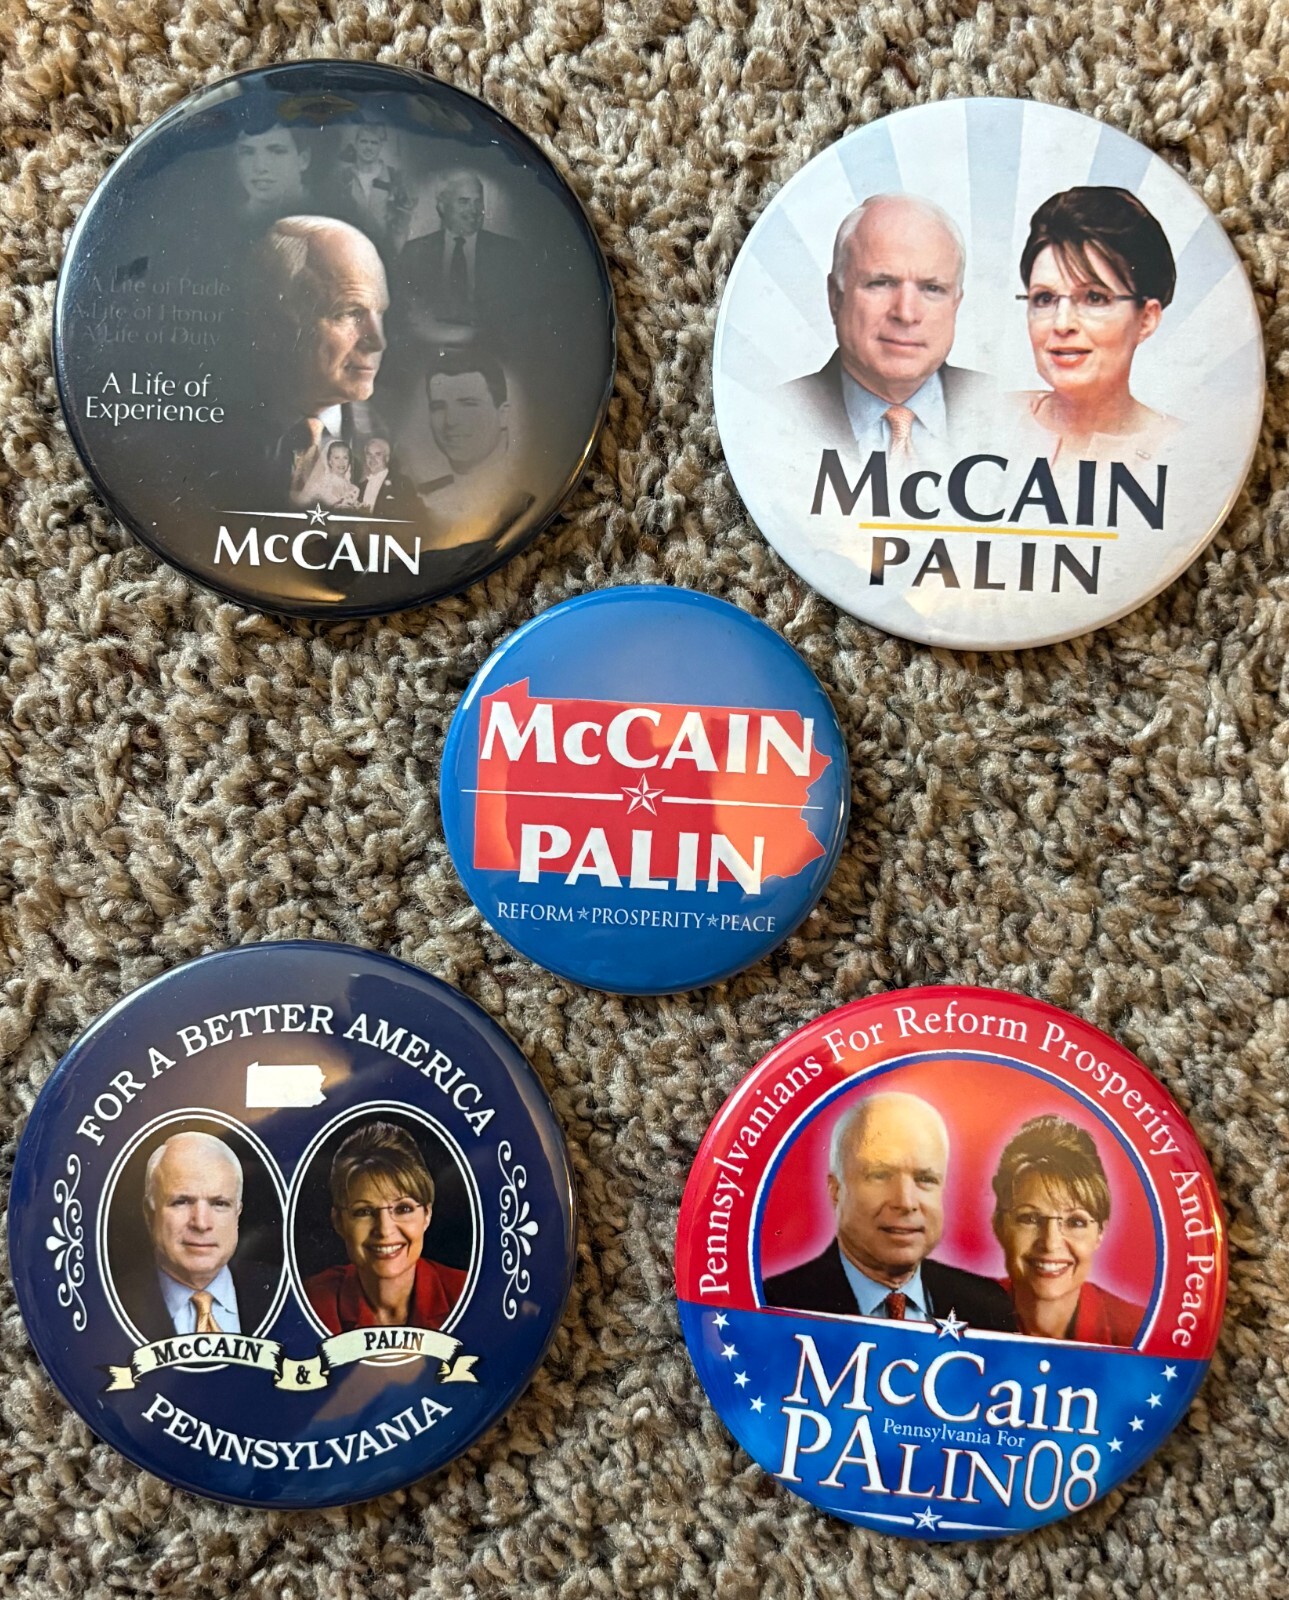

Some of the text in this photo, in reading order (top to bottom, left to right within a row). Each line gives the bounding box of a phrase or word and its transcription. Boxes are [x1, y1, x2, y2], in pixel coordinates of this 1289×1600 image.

[160, 303, 224, 323] Honor
[86, 396, 225, 426] Experience
[102, 371, 212, 397] A Life of
[810, 448, 1168, 530] McCAIN
[214, 525, 421, 575] McCAIN
[869, 536, 1102, 595] PALIN
[480, 701, 814, 777] McCAIN
[518, 823, 765, 895] PALIN
[497, 901, 776, 933] REFORM PROSPERITY PEACE
[77, 1004, 496, 1146] FOR A BETTER AMERICA
[699, 1001, 1214, 1347] Pennsylvanians For Reform Prosperity And Peace
[151, 1331, 425, 1384] McCAIN & PALIN
[782, 1333, 1099, 1435] McCain
[141, 1393, 452, 1470] PENNSYLVANIA
[883, 1418, 1025, 1448] Pennsylvania For
